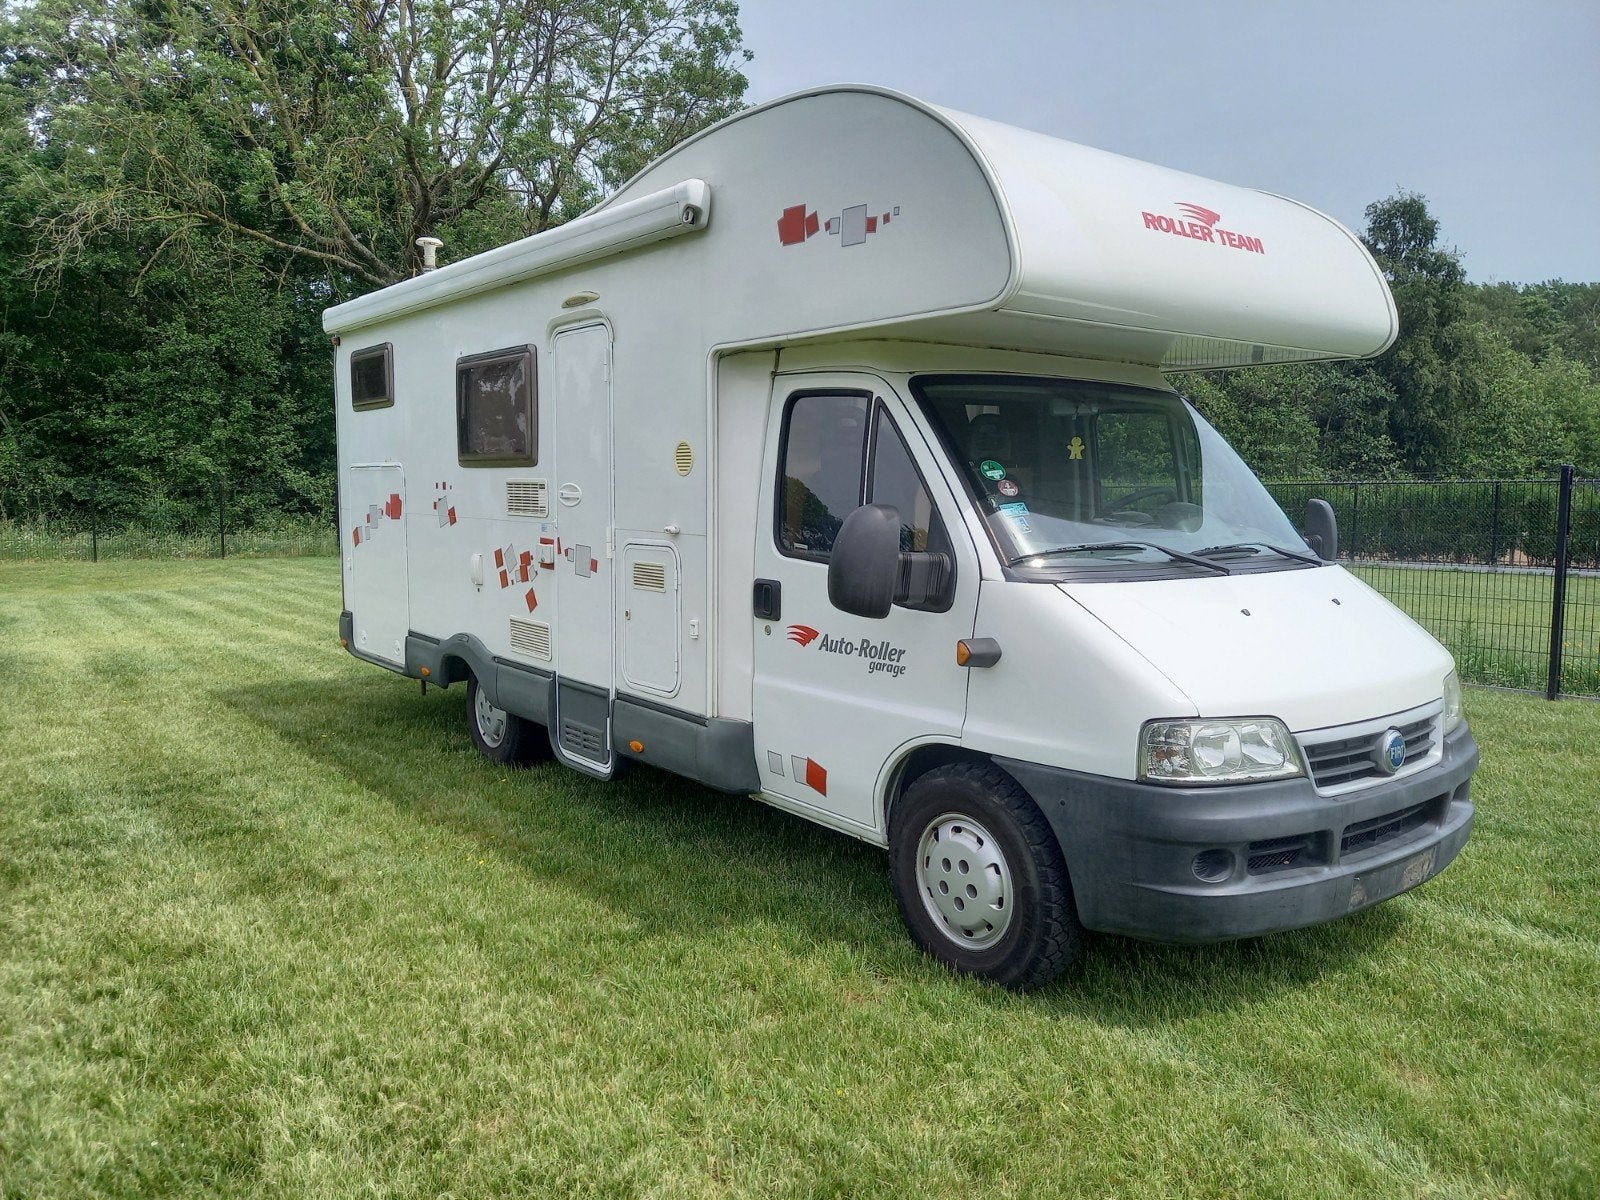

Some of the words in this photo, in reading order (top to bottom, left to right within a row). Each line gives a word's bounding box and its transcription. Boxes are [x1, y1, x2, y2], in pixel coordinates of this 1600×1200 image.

[1141, 211, 1215, 243] ROLLER
[1215, 228, 1265, 255] TEAM
[818, 633, 906, 662] Auto-Roller
[868, 661, 906, 678] garage
[1390, 744, 1405, 759] FIAT
